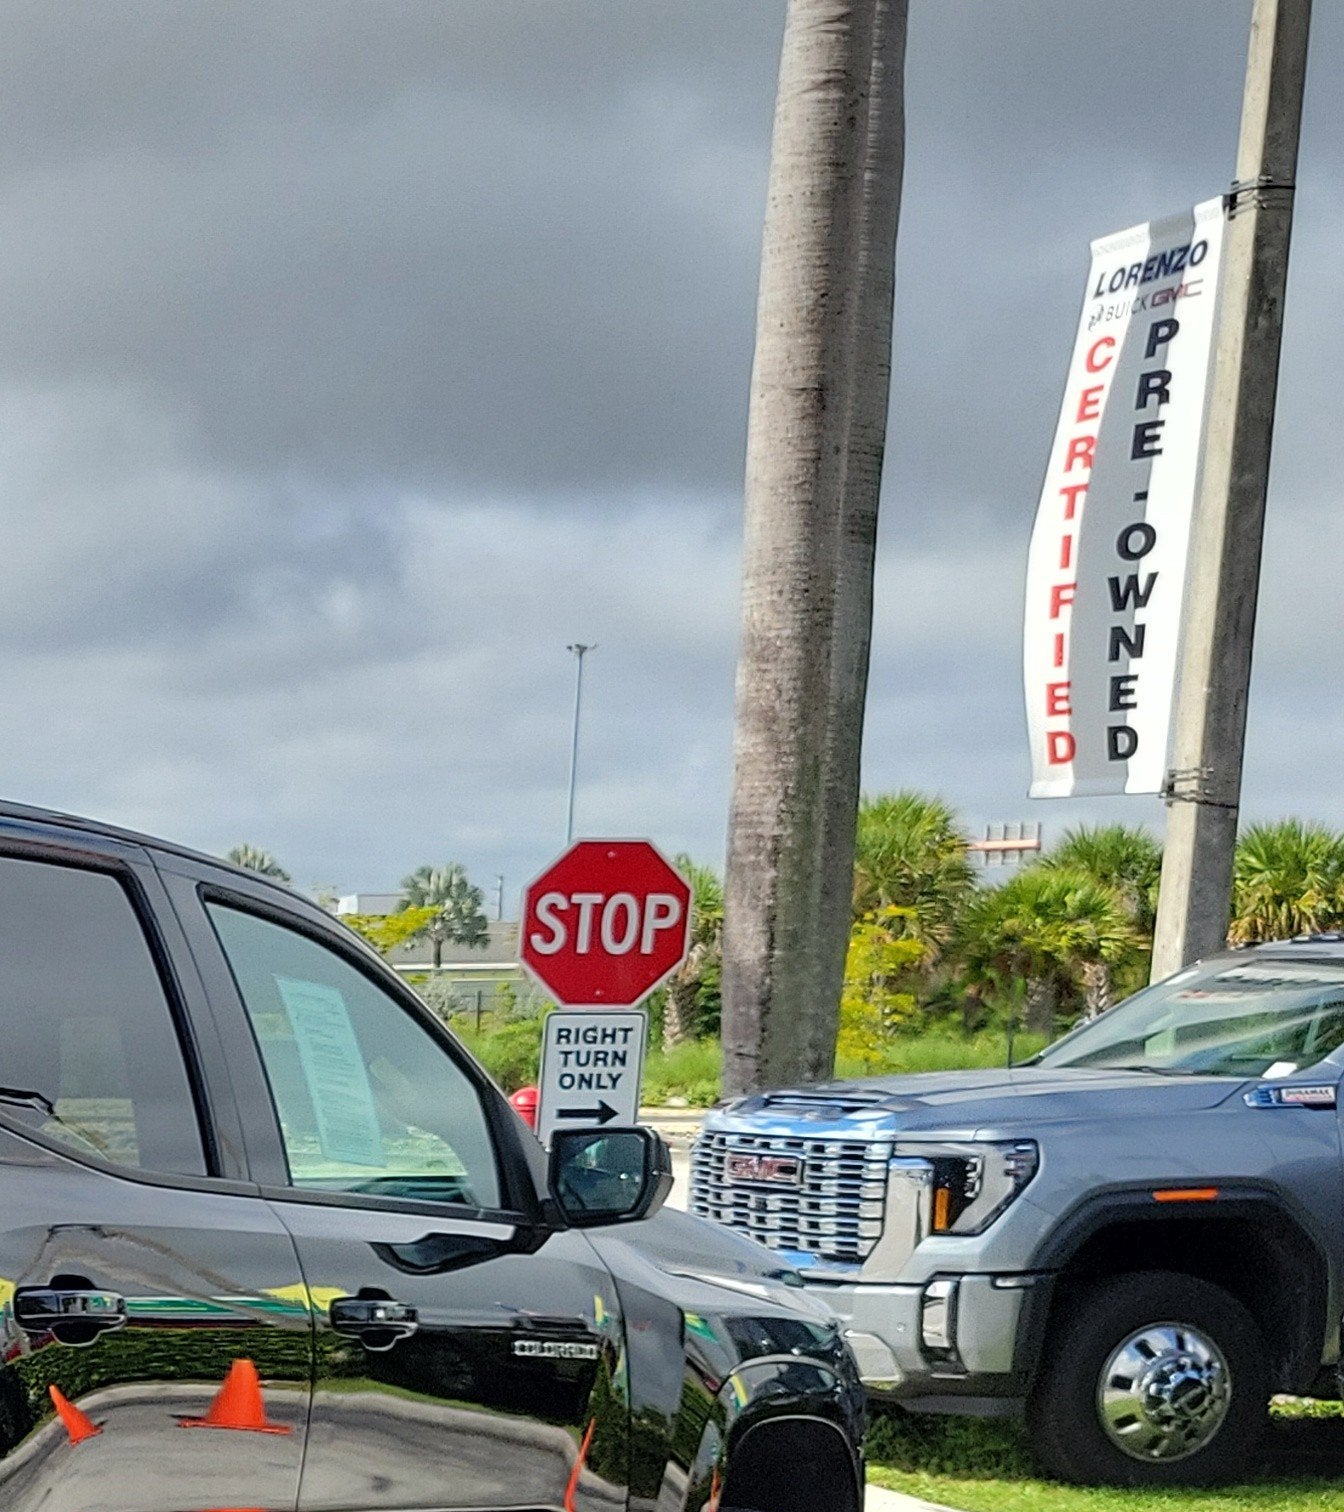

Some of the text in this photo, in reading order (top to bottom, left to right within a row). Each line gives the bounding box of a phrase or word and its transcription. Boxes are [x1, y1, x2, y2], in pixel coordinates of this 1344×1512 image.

[1093, 240, 1209, 299] LORENZO
[1106, 278, 1205, 323] BUICK GMC
[1046, 336, 1116, 765] CERTIFIED
[1107, 318, 1180, 761] PRE-OWNED
[530, 892, 682, 955] STOP
[556, 1026, 634, 1045] RIGHT
[559, 1050, 628, 1068] TURN
[559, 1073, 623, 1090] ONLY
[514, 1339, 598, 1360] COLORADO
